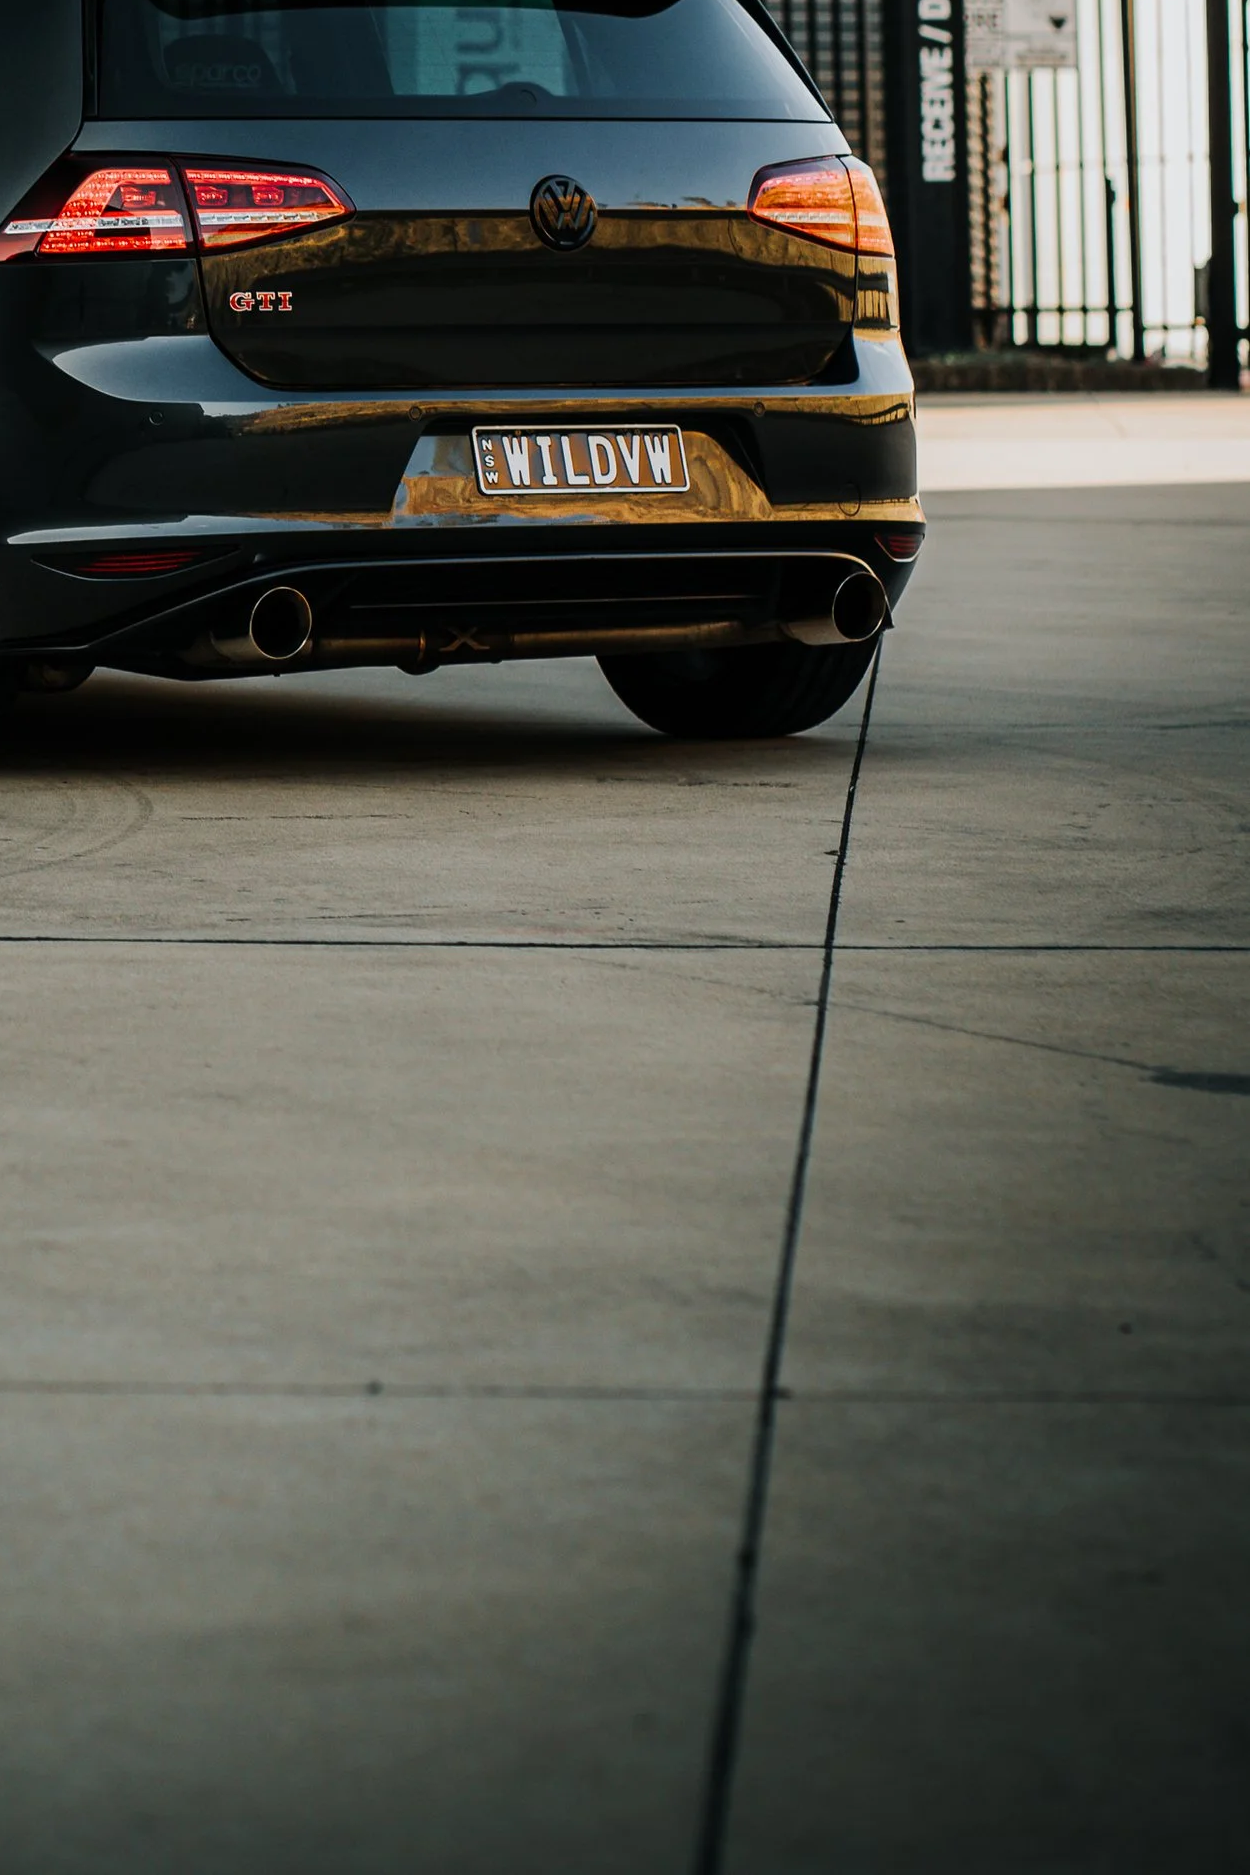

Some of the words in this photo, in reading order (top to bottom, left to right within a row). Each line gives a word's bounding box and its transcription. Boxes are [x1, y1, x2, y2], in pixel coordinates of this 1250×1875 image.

[919, 46, 956, 182] RECEIVE
[229, 291, 293, 313] GTI
[481, 438, 499, 485] NSW
[501, 434, 672, 486] WILDVW
